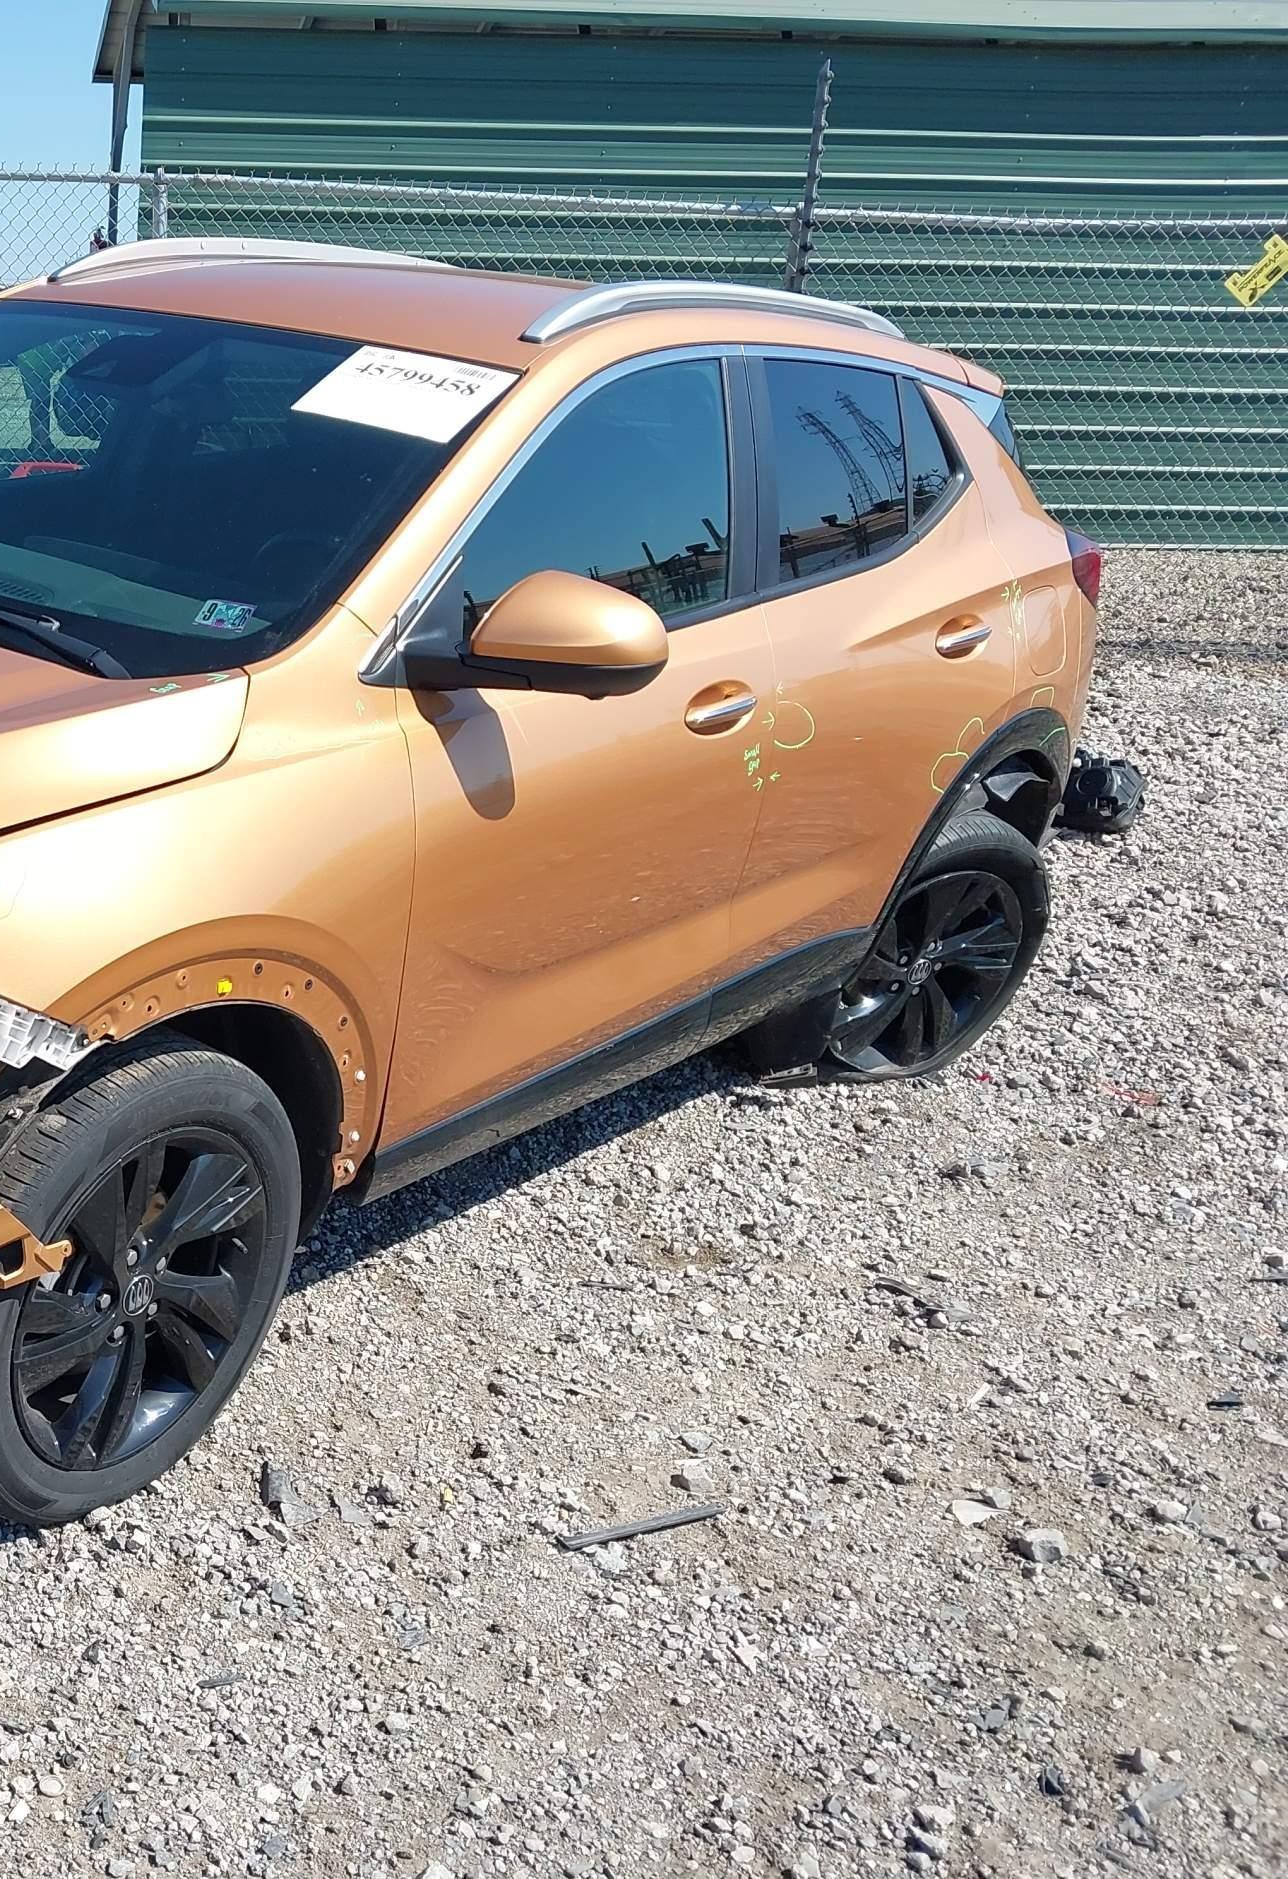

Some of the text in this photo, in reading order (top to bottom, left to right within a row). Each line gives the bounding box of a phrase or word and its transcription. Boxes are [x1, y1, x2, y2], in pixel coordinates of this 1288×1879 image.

[355, 362, 481, 396] 45799458
[202, 603, 252, 626] 9 26
